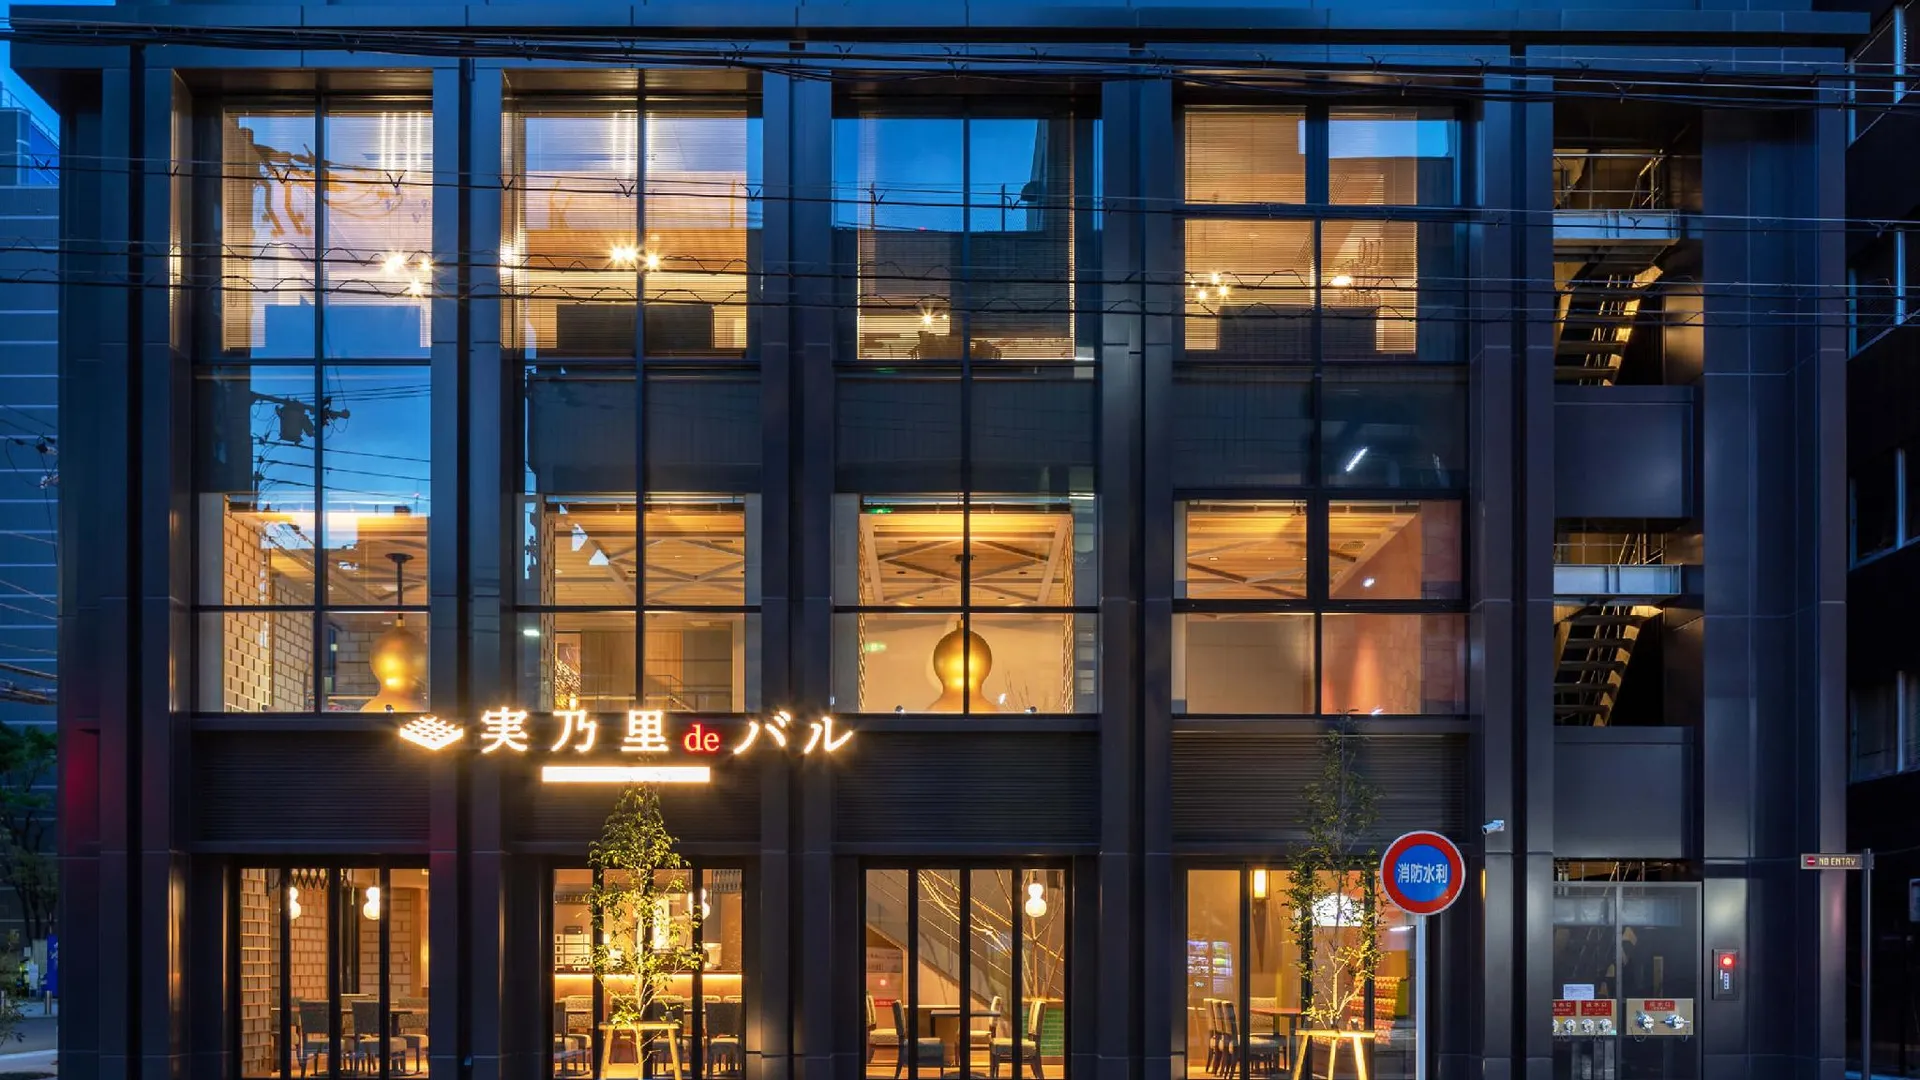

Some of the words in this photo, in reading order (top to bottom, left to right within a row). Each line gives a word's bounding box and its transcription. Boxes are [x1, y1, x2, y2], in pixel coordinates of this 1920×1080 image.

[481, 708, 669, 753] 実乃里
[683, 724, 720, 752] de
[733, 711, 854, 755] バル
[1818, 857, 1829, 866] NO
[1830, 857, 1856, 866] ENTRY
[1397, 862, 1448, 884] 消防水利
